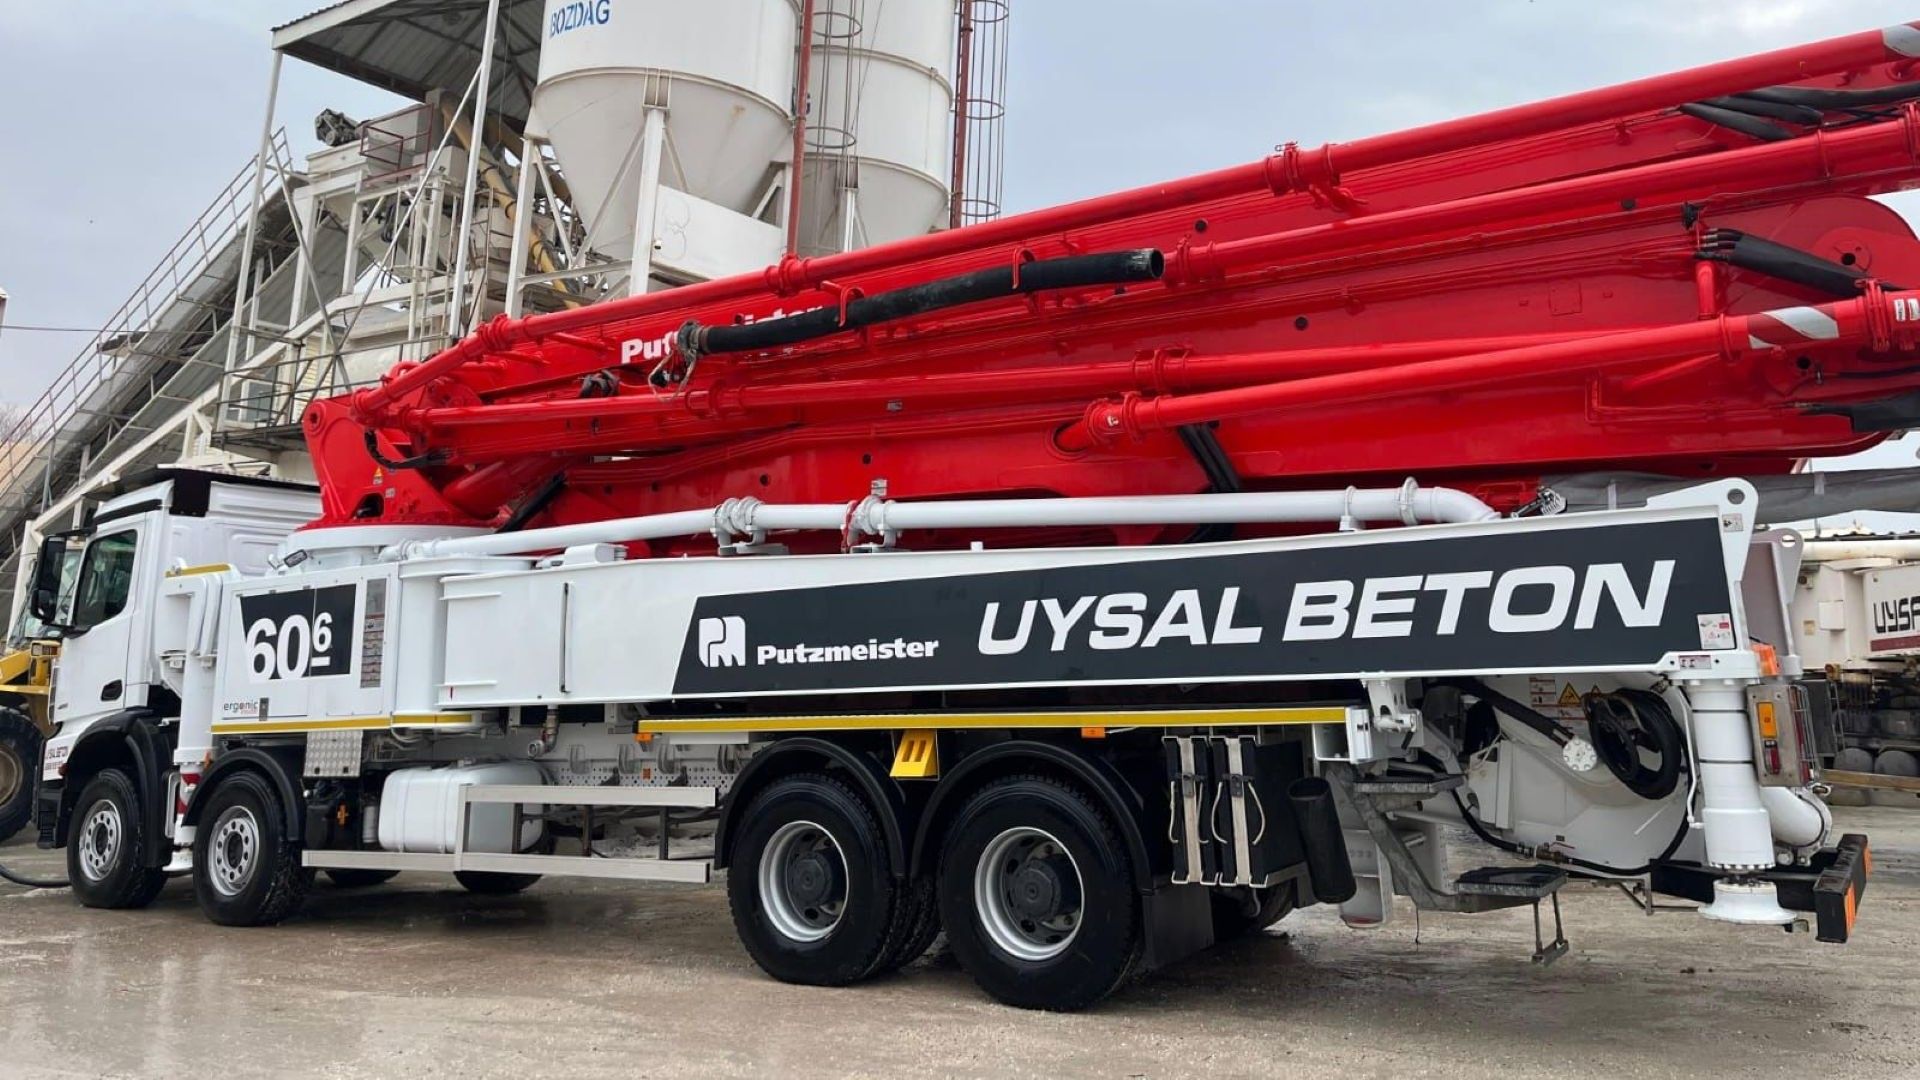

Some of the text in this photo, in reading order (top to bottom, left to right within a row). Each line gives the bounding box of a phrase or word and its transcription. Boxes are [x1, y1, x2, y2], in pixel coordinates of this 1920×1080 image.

[978, 586, 1263, 655] UYSAL
[1282, 559, 1676, 641] BETON
[757, 637, 939, 665] Putzmeister
